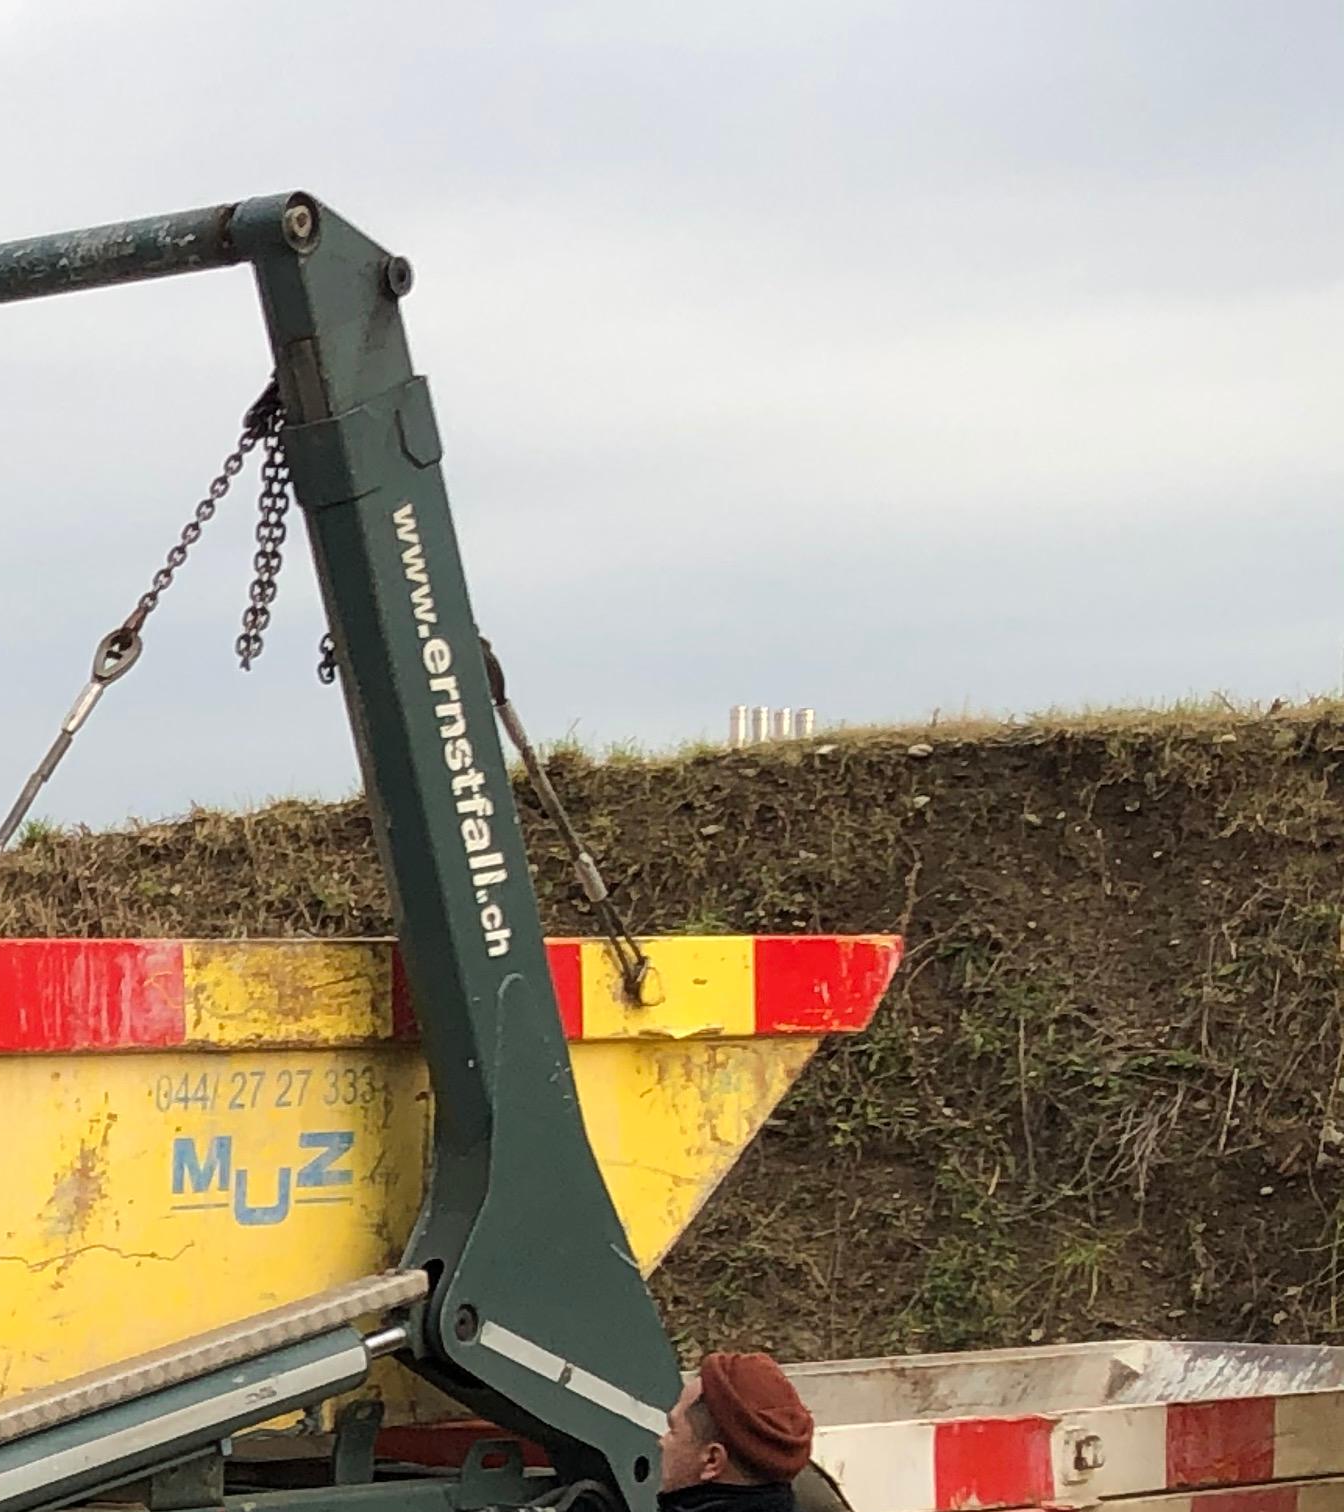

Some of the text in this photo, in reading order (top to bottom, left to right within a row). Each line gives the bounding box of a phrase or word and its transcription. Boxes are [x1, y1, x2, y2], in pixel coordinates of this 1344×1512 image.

[392, 502, 513, 958] www.ernstfall.ch
[229, 1071, 266, 1110] 27
[275, 1069, 313, 1108] 27
[324, 1065, 378, 1105] 333
[171, 1131, 355, 1226] MUZ
